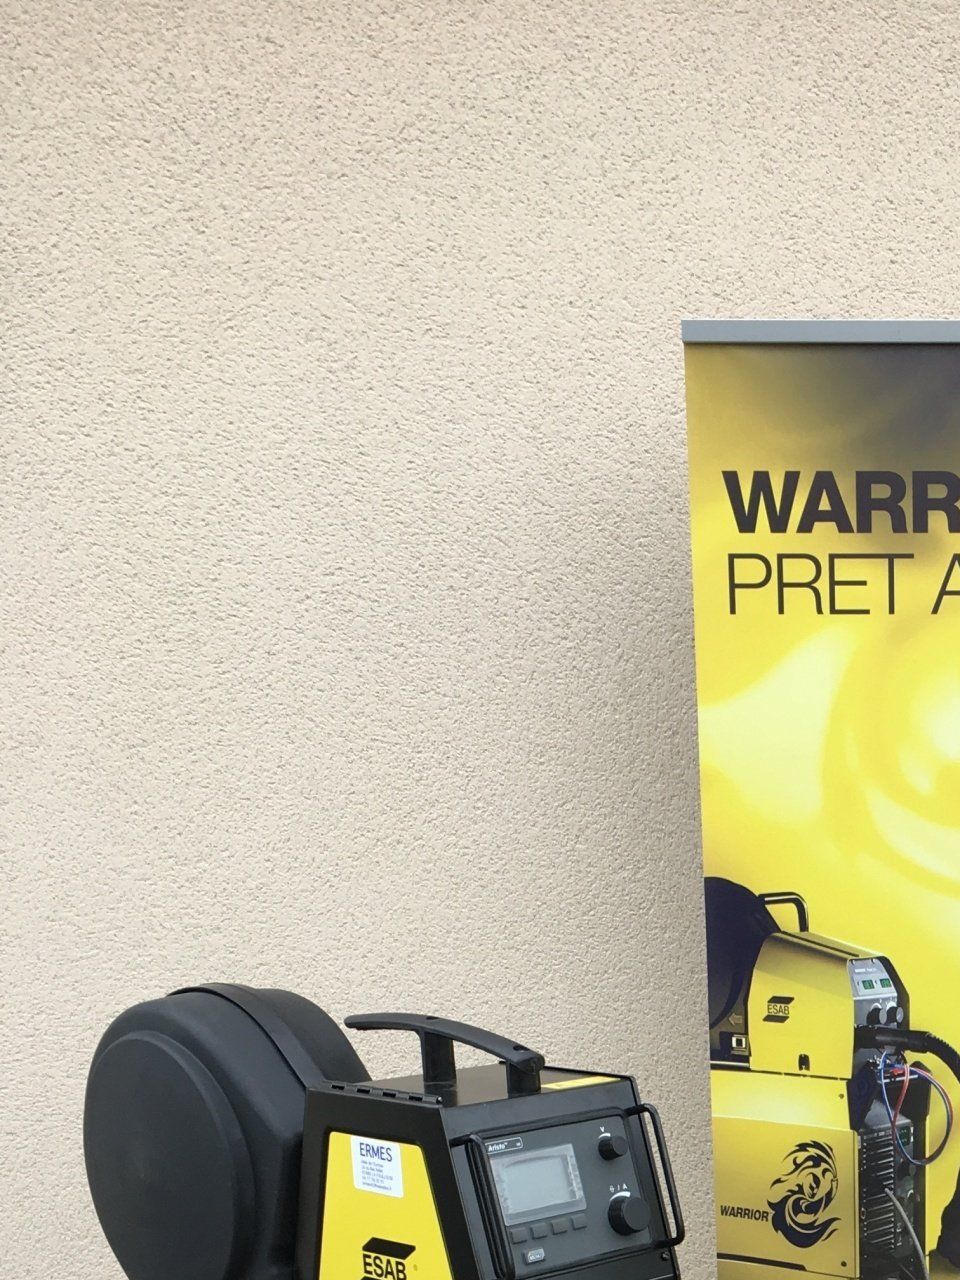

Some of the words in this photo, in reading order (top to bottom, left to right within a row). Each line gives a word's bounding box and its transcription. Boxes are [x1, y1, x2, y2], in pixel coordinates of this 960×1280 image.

[727, 552, 914, 616] PRET
[767, 1003, 790, 1016] ESAB
[359, 1141, 393, 1163] ERMES
[720, 1204, 769, 1223] WARRIOR
